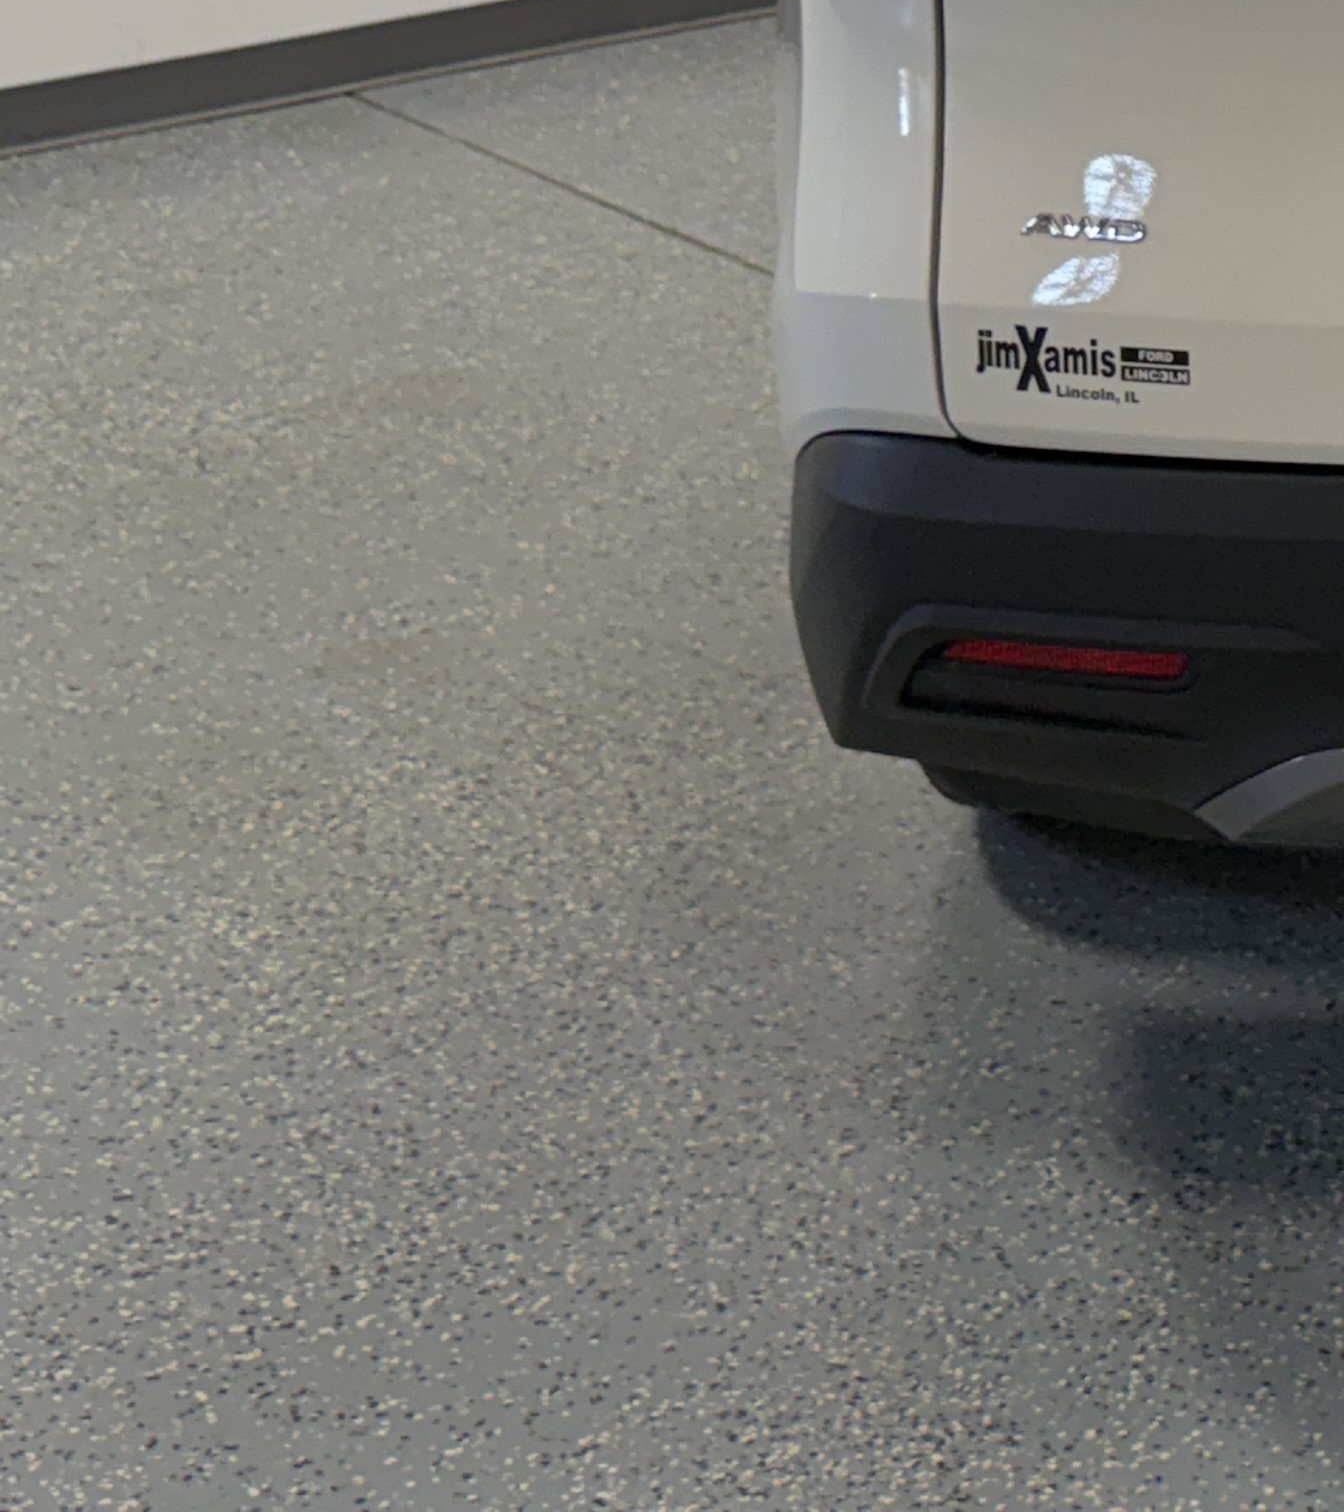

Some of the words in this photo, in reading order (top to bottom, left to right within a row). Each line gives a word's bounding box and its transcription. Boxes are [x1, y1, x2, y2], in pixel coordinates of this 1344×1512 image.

[1020, 213, 1147, 243] AWD
[976, 324, 1116, 393] jimXamis
[1138, 349, 1175, 363] FORD
[1123, 367, 1190, 384] LINCOLN
[1056, 385, 1120, 404] Lincoln,
[1124, 390, 1140, 404] IL
